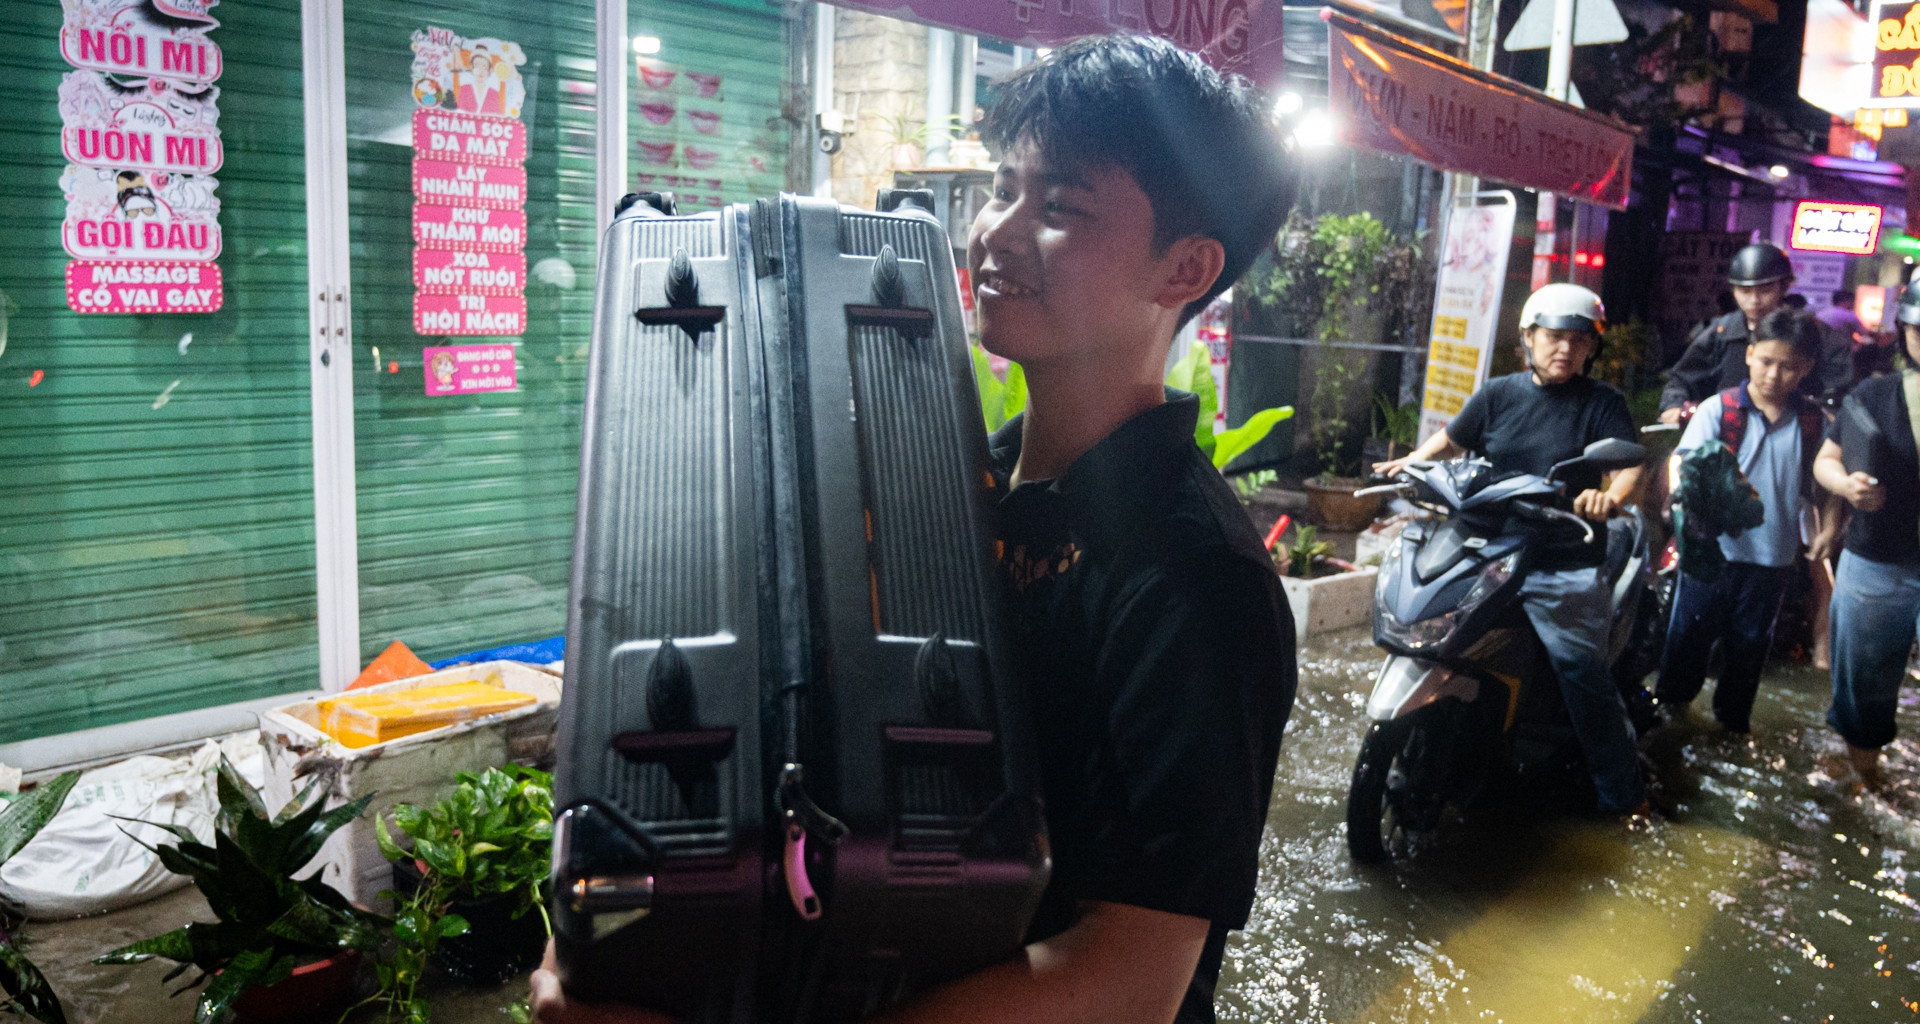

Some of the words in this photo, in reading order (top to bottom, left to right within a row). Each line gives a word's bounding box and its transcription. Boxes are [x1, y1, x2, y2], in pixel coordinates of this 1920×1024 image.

[79, 21, 147, 68] NỐI
[162, 39, 206, 75] MI
[77, 119, 154, 163] UỐN
[165, 134, 208, 167] MI
[430, 132, 461, 152] DA
[77, 213, 133, 255] GỘI
[143, 212, 209, 251] ĐẦU
[481, 223, 520, 244] MÔI
[92, 265, 200, 284] MASSAGE
[424, 263, 465, 285] NỐT
[118, 289, 159, 307] VAI
[166, 286, 213, 307] GÁY
[422, 308, 461, 330] HÔI
[466, 309, 519, 330] NÁCH
